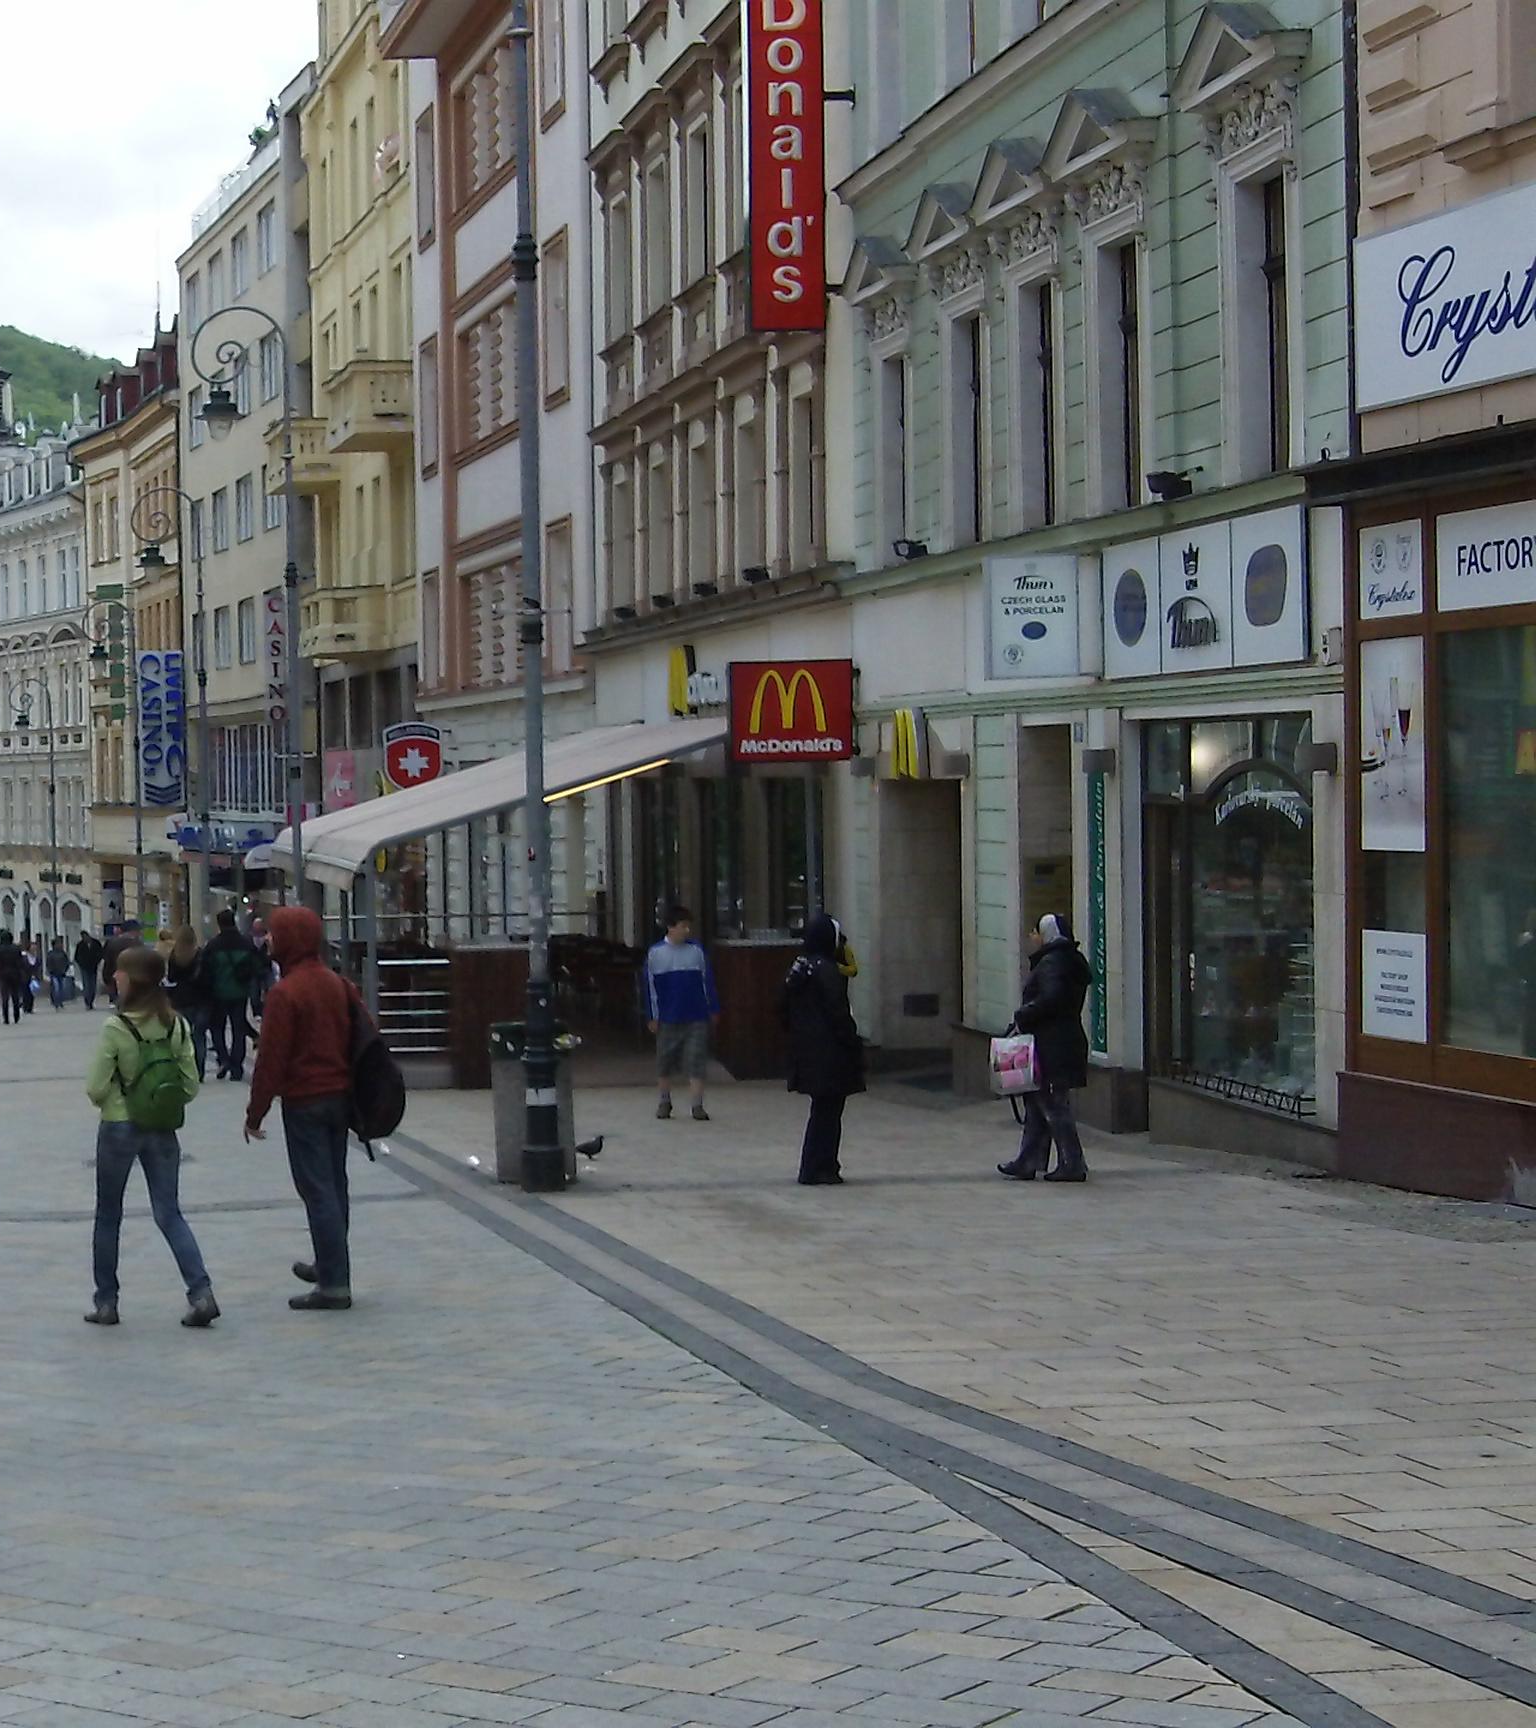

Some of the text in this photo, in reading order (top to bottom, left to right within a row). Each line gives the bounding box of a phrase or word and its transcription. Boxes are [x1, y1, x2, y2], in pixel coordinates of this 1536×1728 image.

[1398, 245, 1536, 384] Cryst
[1457, 534, 1536, 577] FACTOR
[267, 597, 286, 721] CASINO
[740, 737, 843, 754] McDonald's
